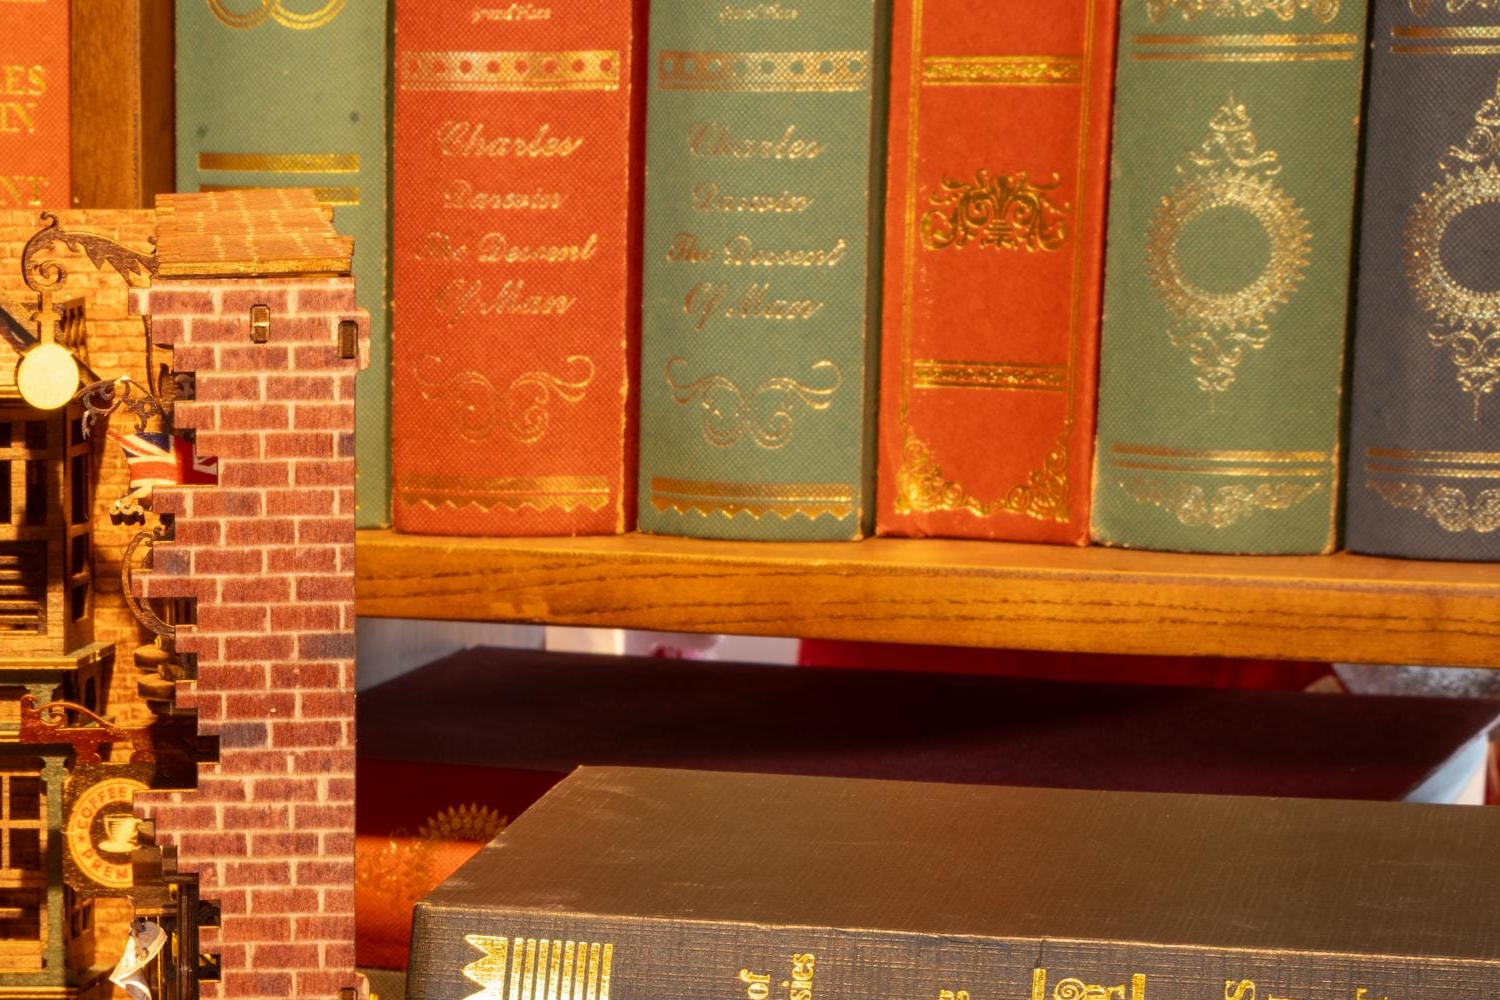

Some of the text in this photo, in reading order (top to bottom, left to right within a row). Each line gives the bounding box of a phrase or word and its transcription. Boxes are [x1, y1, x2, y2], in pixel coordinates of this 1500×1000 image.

[437, 120, 584, 157] Charles
[688, 122, 825, 159] Charles
[739, 968, 771, 1000] of
